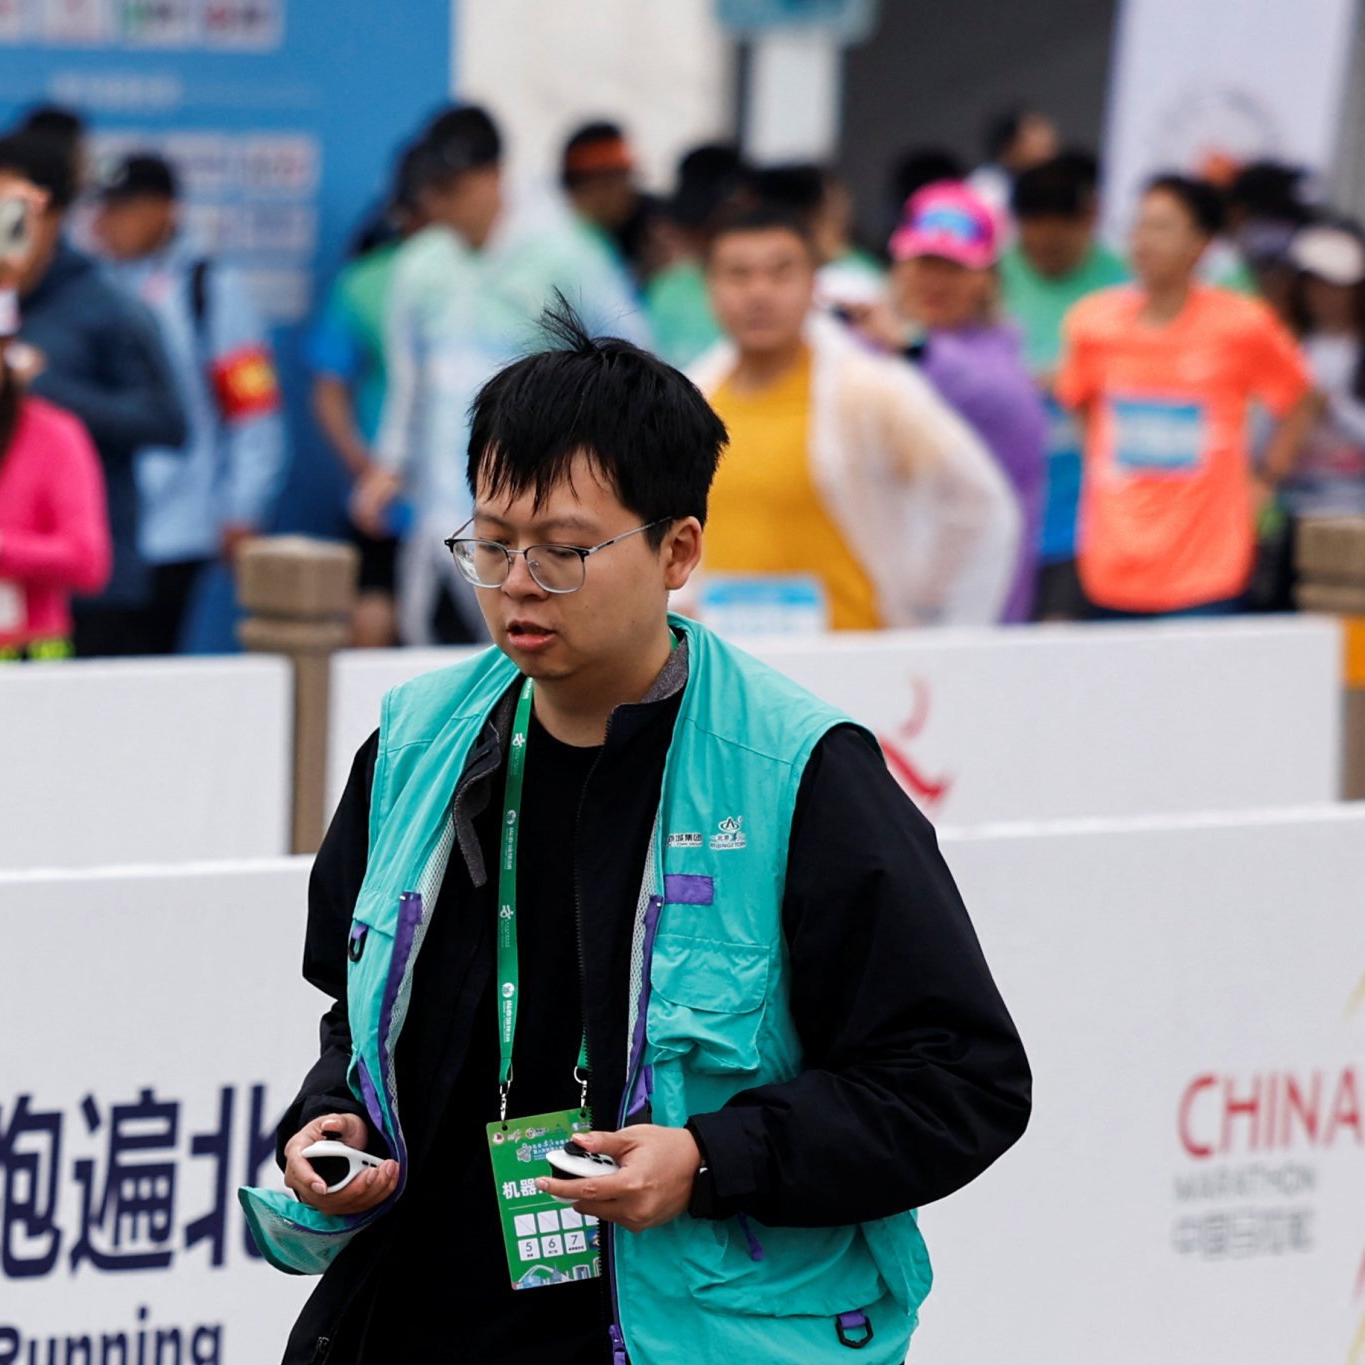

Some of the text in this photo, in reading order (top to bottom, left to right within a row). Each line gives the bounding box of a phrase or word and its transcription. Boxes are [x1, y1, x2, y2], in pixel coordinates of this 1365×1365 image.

[1177, 1064, 1365, 1161] CHINA
[502, 1178, 543, 1200] 机器
[525, 1242, 533, 1253] 5
[548, 1237, 556, 1249] 6
[571, 1234, 579, 1246] 7
